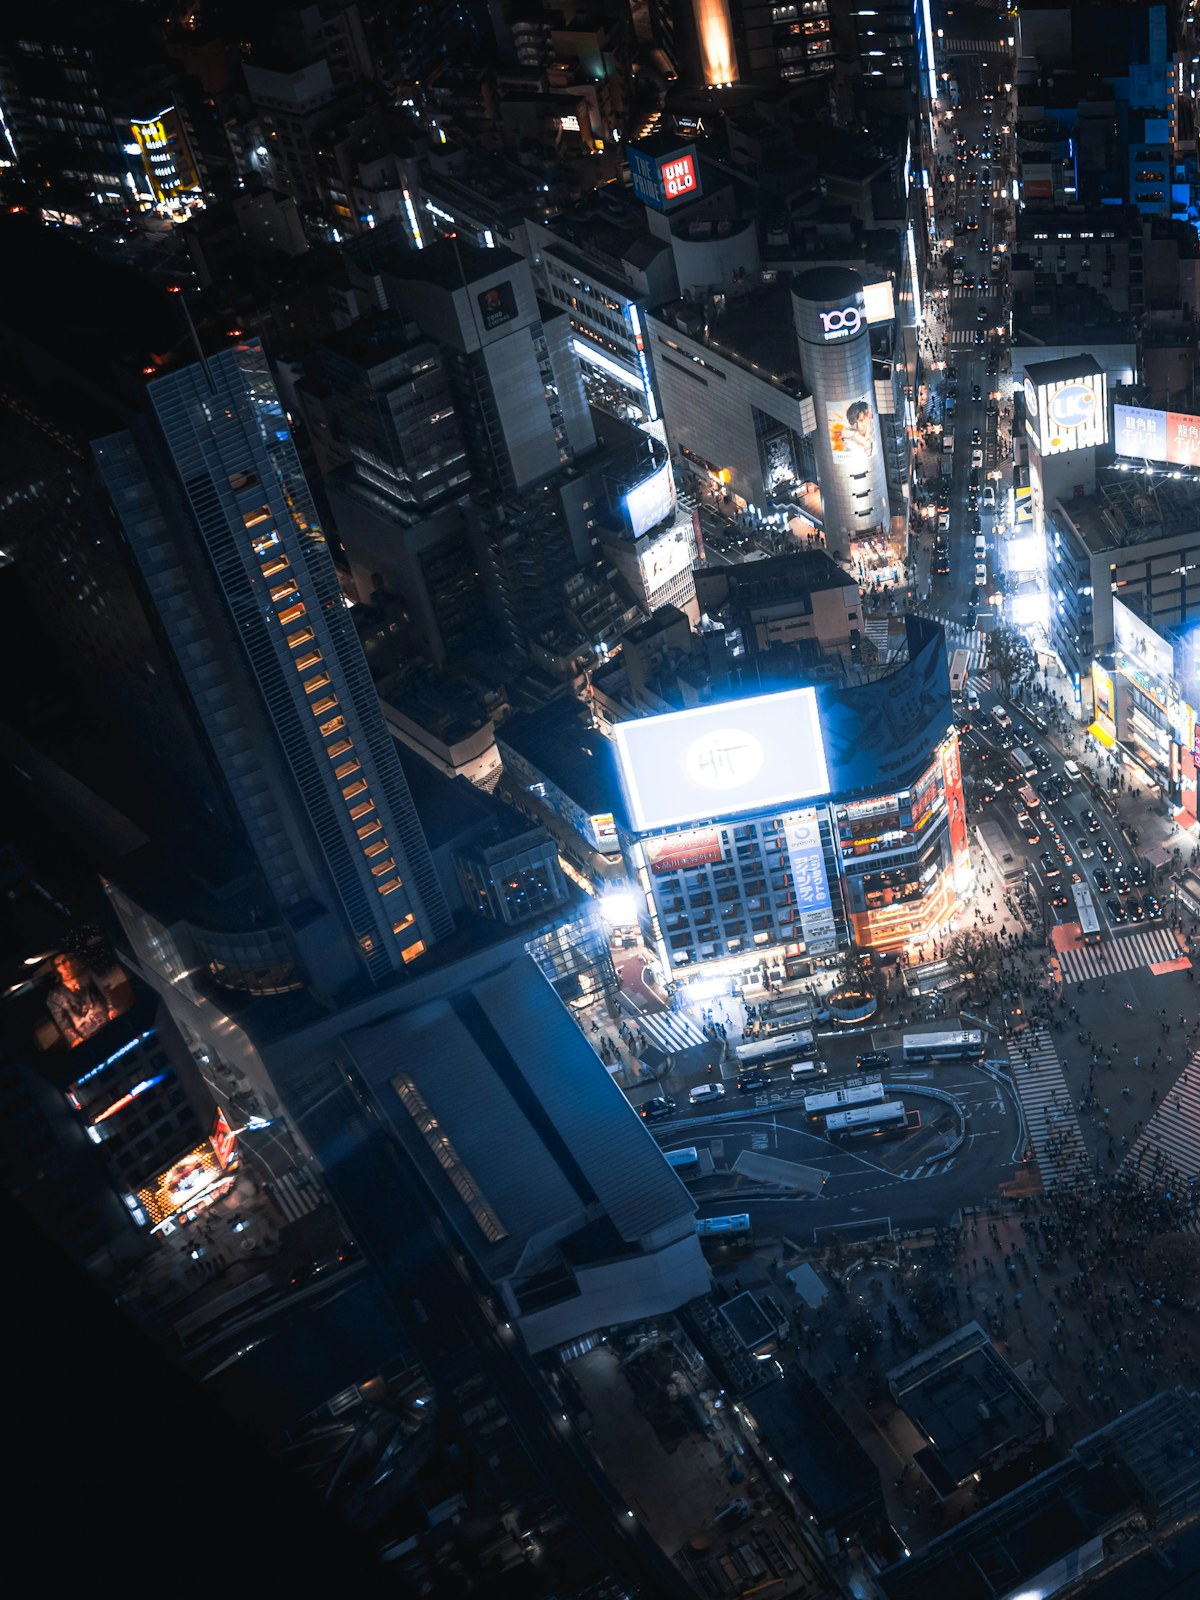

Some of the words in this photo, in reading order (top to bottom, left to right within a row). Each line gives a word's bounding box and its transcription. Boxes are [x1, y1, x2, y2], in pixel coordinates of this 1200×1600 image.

[634, 155, 652, 180] THE
[665, 160, 689, 180] UNI
[633, 172, 661, 202] PRIME
[668, 174, 693, 195] QLO
[820, 307, 861, 335] 109
[791, 837, 817, 848] eyecity
